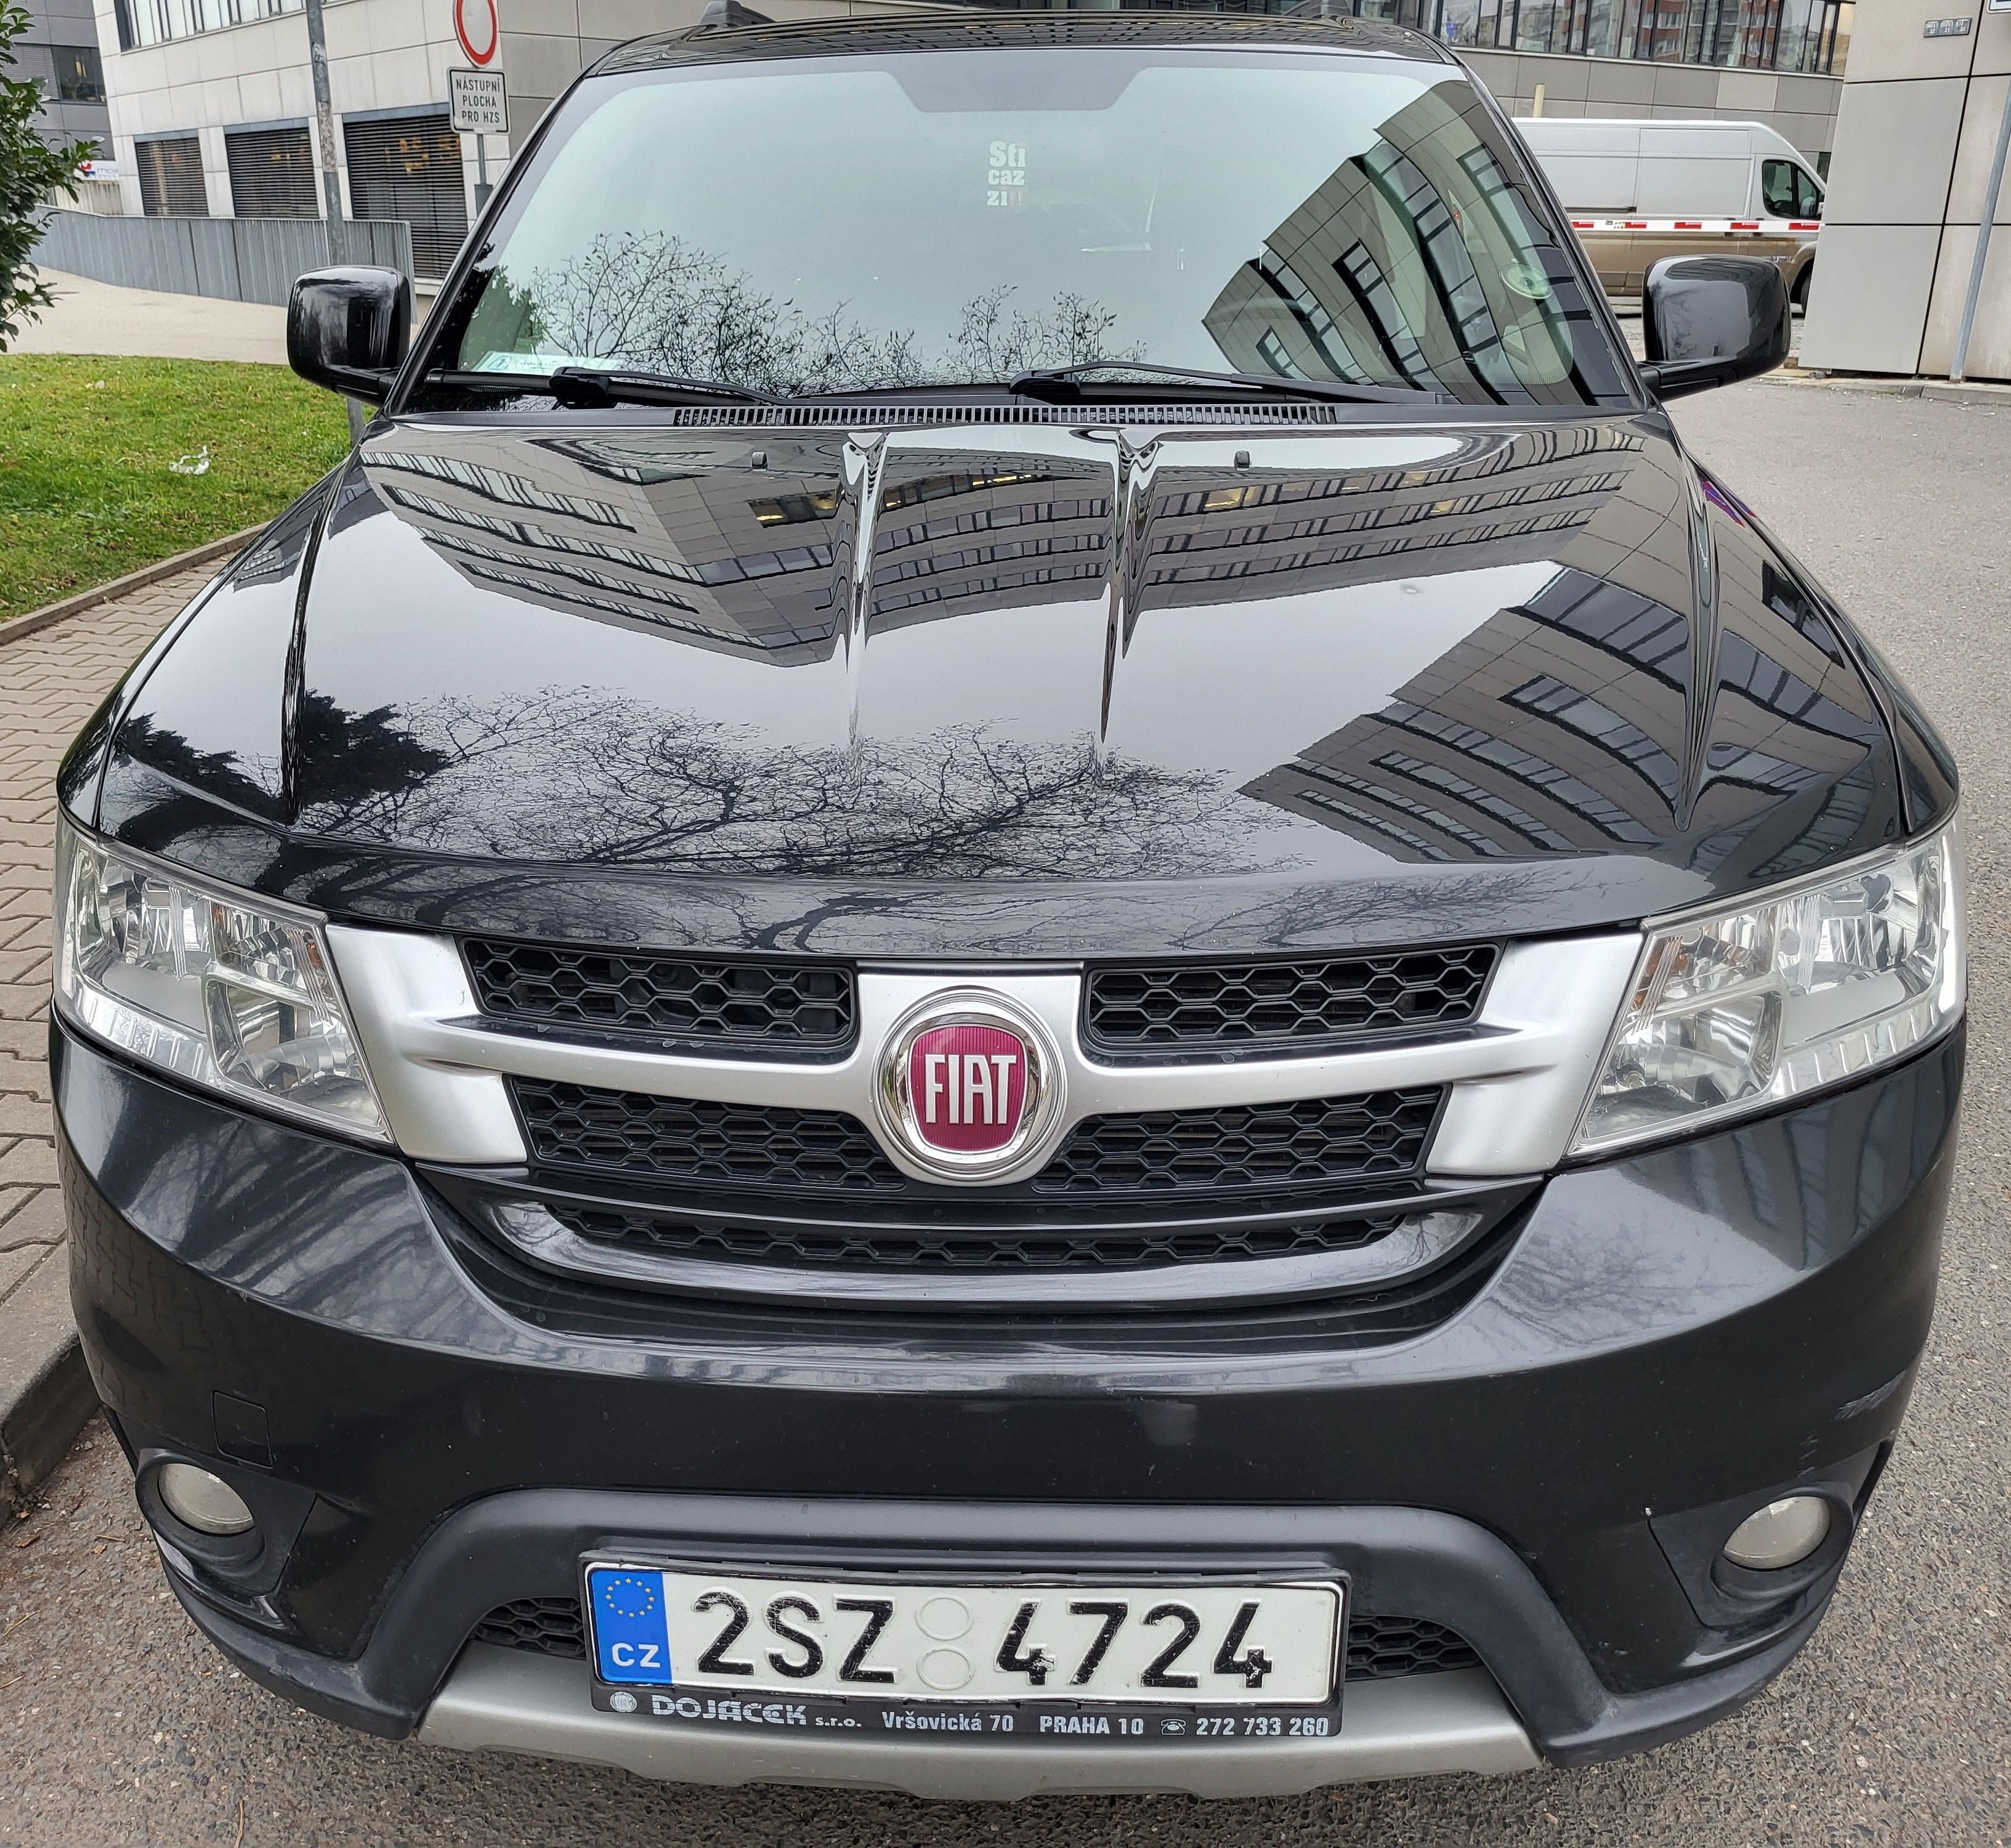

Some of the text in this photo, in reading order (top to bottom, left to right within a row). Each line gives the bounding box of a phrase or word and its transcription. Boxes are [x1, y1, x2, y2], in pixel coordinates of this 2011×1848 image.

[456, 76, 500, 92] NÁSTUPNÍ
[463, 95, 497, 108] PLOCHA
[462, 110, 500, 123] PRO HZS
[988, 169, 1025, 185] caz
[925, 1054, 1016, 1124] FIAT
[694, 1591, 1273, 1688] 2SZ 4724
[612, 1642, 661, 1668] CZ
[815, 1716, 862, 1727] s.r.o.
[881, 1711, 982, 1732] Vršovická
[989, 1714, 1014, 1732] 70
[1039, 1716, 1110, 1735] PRAHA
[1118, 1718, 1144, 1735] 10
[1196, 1717, 1235, 1736] 272
[1243, 1717, 1281, 1736] 733
[1289, 1717, 1329, 1736] 260
